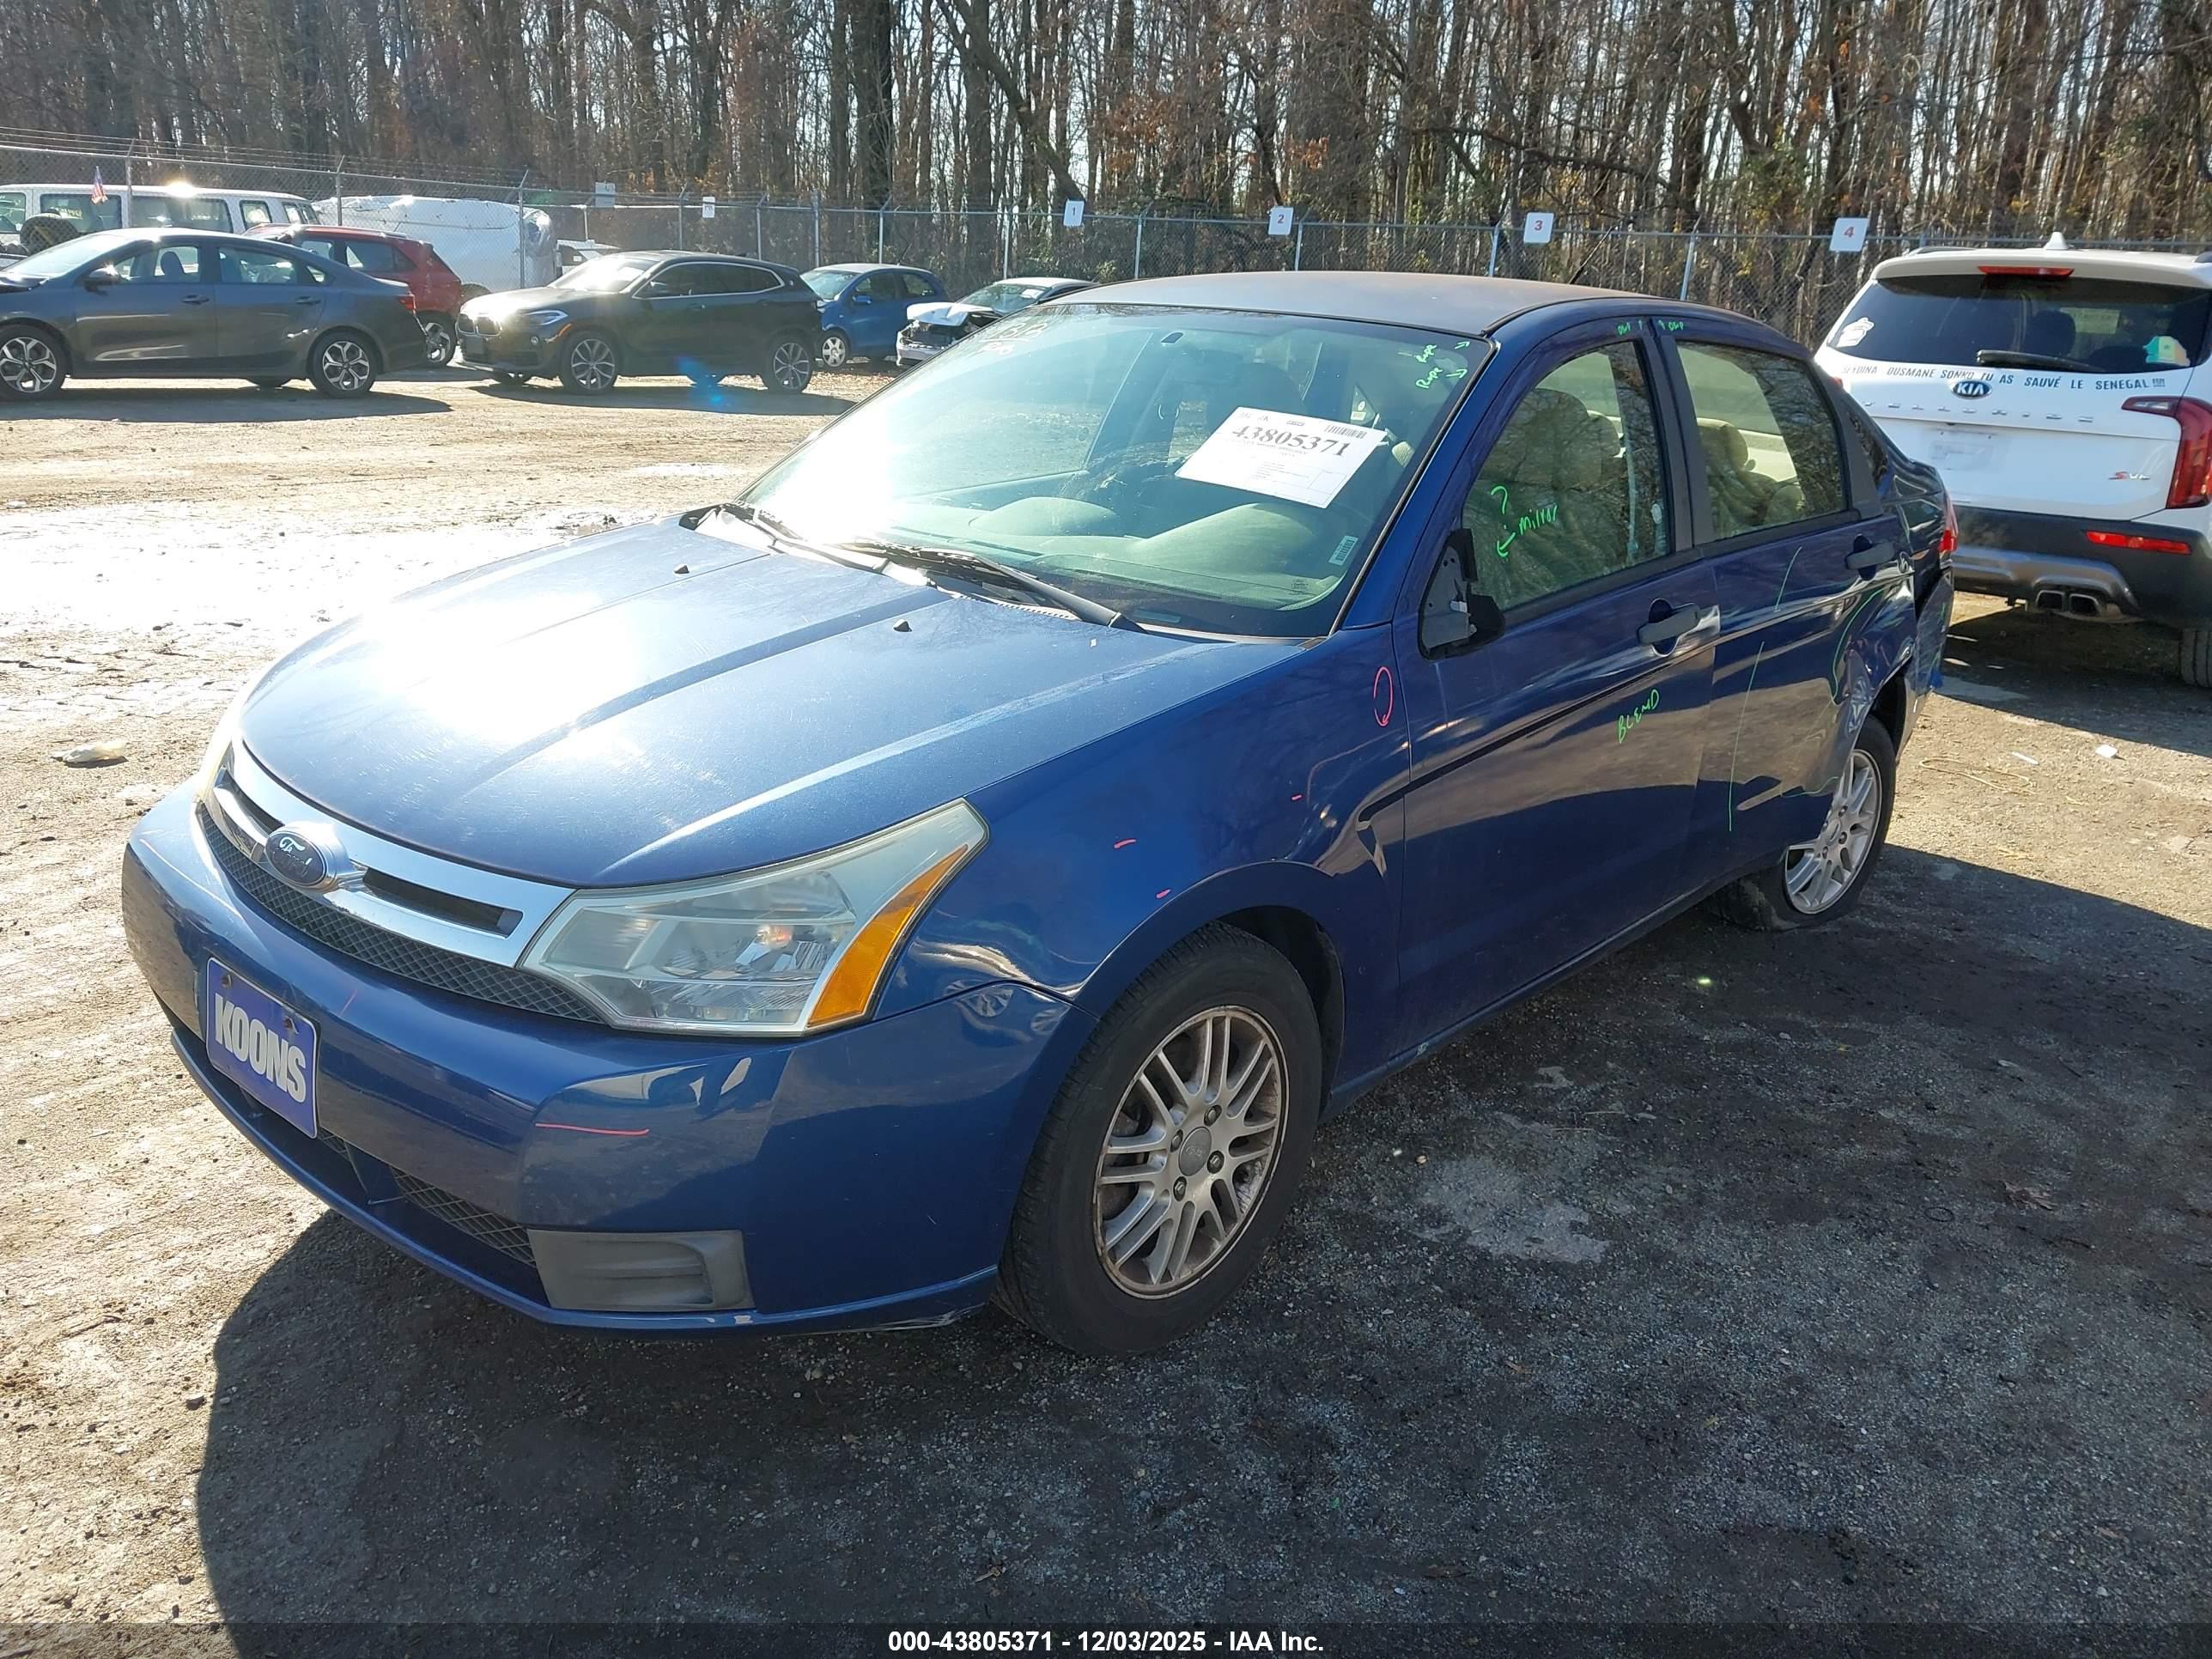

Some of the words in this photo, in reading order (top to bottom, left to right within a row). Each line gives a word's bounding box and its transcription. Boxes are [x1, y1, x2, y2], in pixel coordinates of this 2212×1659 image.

[1277, 214, 1285, 224] 2
[1534, 220, 1543, 231] 3
[1844, 226, 1855, 238] 4
[1887, 367, 1935, 379] OUSMANE
[1940, 369, 1975, 380] SONKO
[1980, 372, 1994, 381] TU
[1999, 374, 2014, 385] AS
[2024, 375, 2062, 388] SAUVÉ
[2070, 379, 2084, 389] LE
[2095, 379, 2149, 390] SENEGAL
[1956, 382, 1984, 395] KIA
[1231, 424, 1352, 457] 43805371
[215, 993, 307, 1103] KOONS
